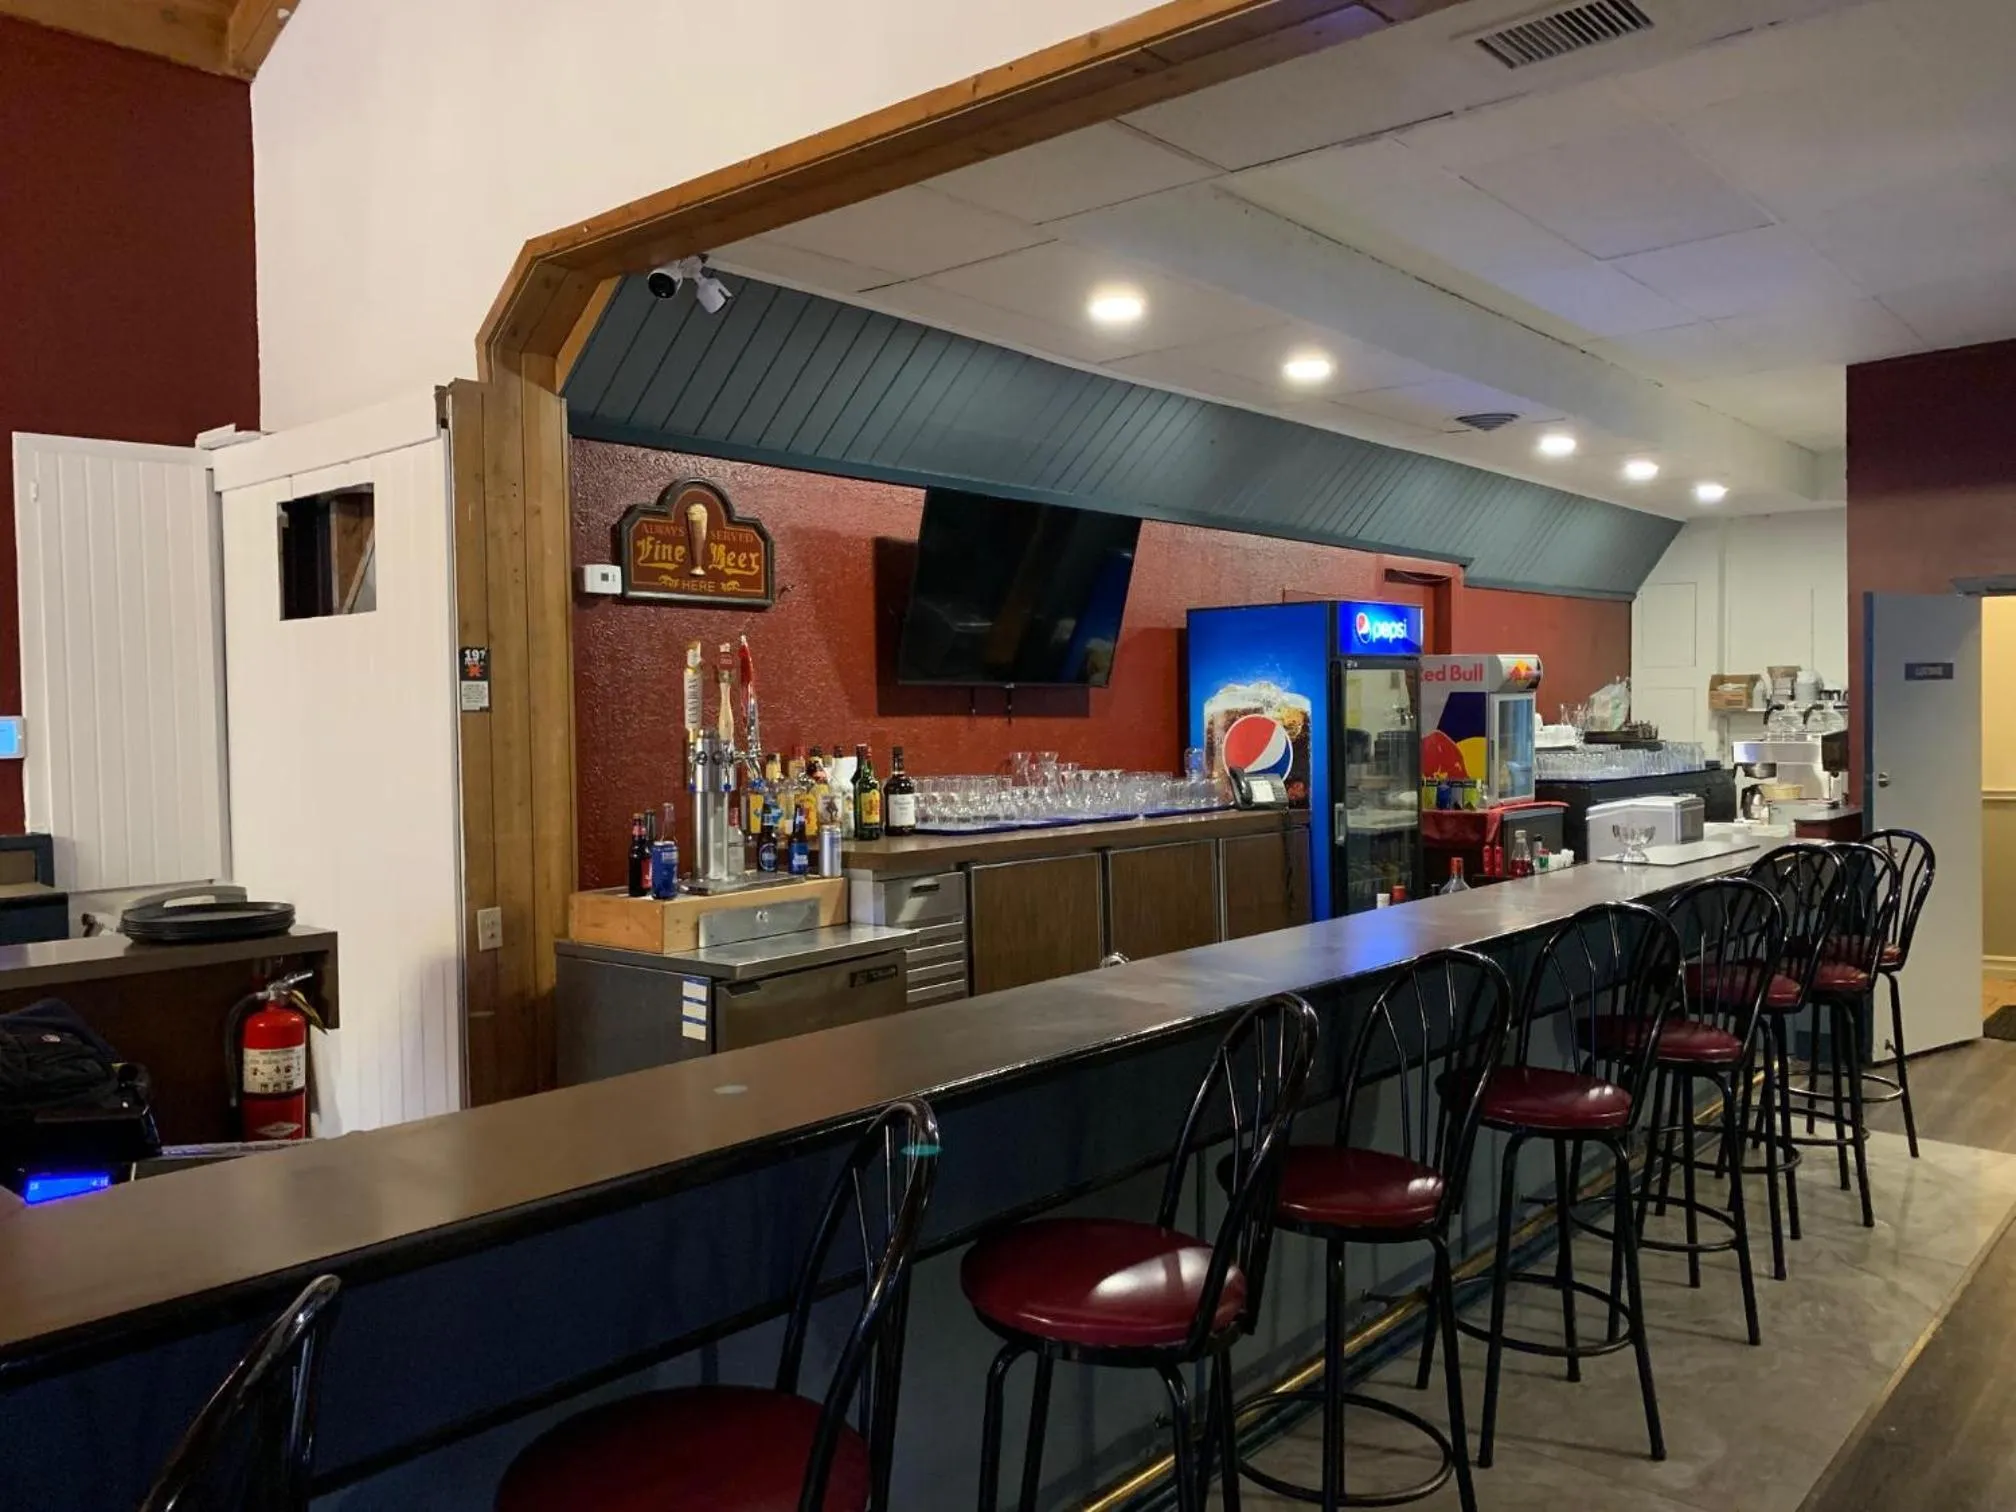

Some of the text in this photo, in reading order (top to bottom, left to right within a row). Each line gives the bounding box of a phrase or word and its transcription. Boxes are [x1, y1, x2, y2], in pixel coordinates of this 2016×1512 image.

[641, 524, 755, 544] ALWAYS SERVED
[637, 536, 760, 575] Fine Beer
[681, 580, 717, 592] HERE
[1372, 618, 1408, 643] pepsi
[1450, 663, 1483, 682] Bull
